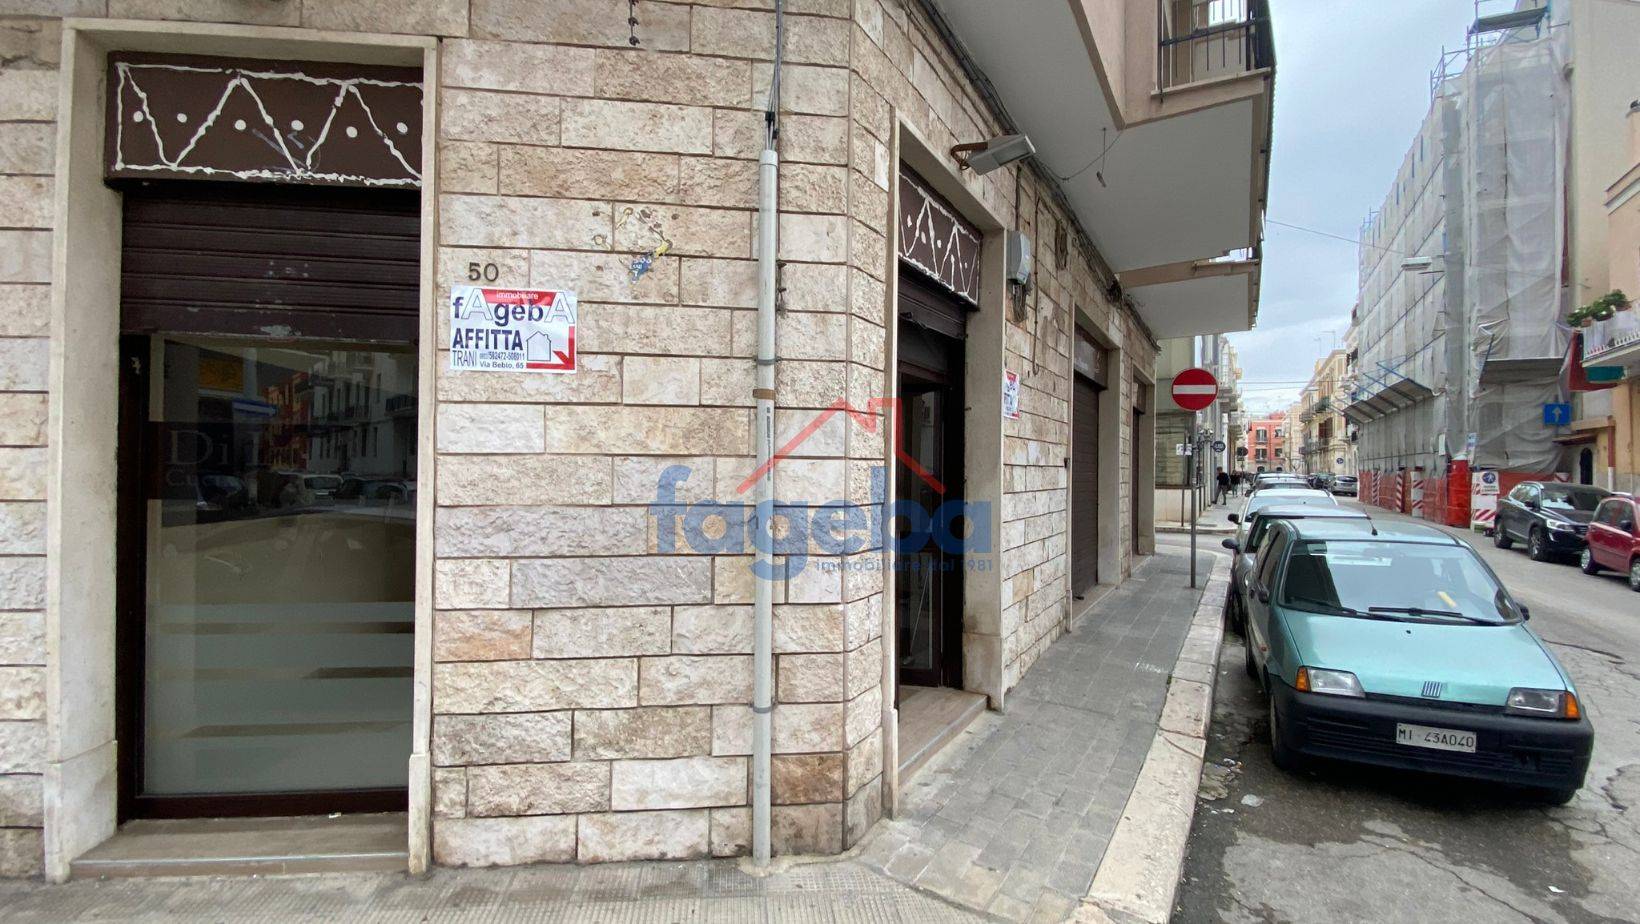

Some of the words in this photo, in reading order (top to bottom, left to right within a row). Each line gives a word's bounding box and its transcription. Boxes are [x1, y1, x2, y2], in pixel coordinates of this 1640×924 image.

[468, 262, 499, 282] 50
[452, 328, 524, 351] AFFITTA
[452, 350, 478, 367] TRANI
[1399, 729, 1412, 740] MI
[1424, 732, 1474, 748] 43A040
